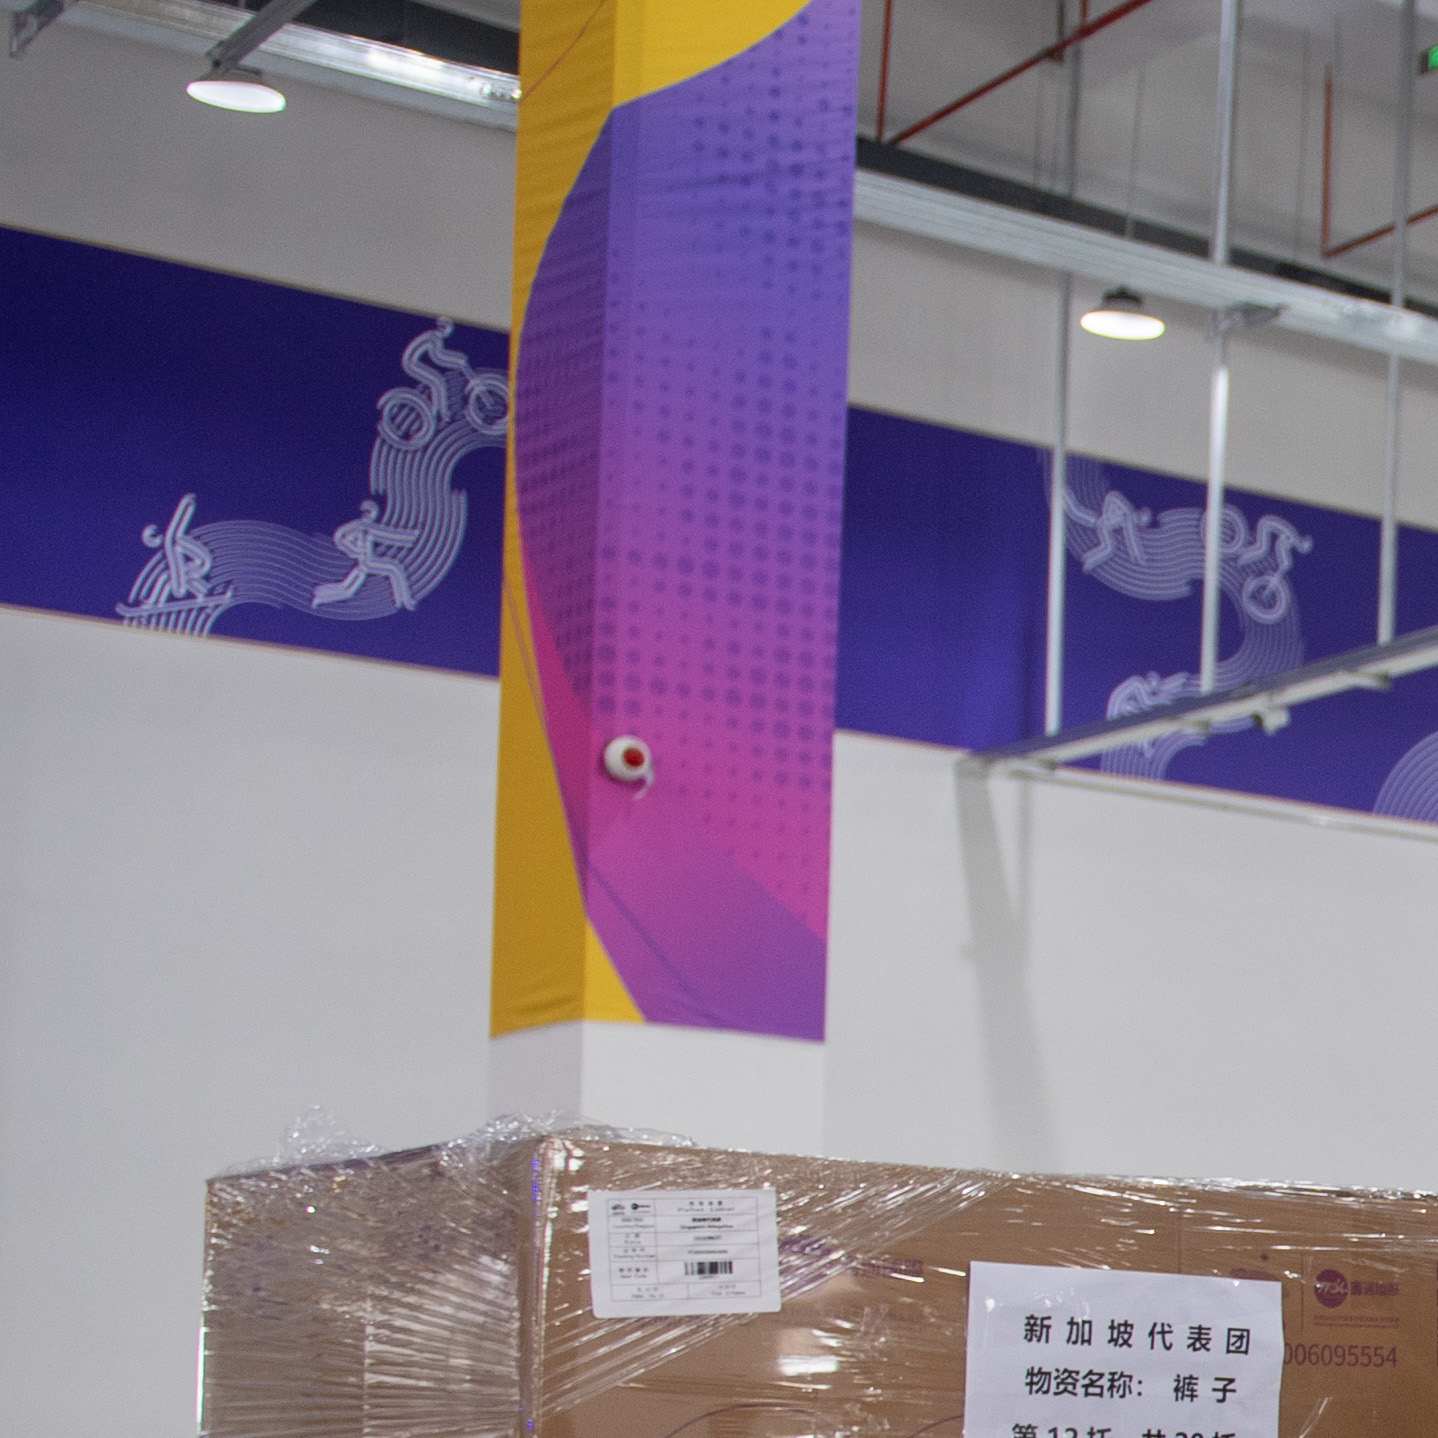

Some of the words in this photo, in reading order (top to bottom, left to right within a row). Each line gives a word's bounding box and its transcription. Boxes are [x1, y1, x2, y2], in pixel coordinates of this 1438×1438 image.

[1023, 1314, 1250, 1356] 新加坡代表团
[1025, 1366, 1144, 1399] 物资名称：
[1173, 1374, 1238, 1404] 裤子
